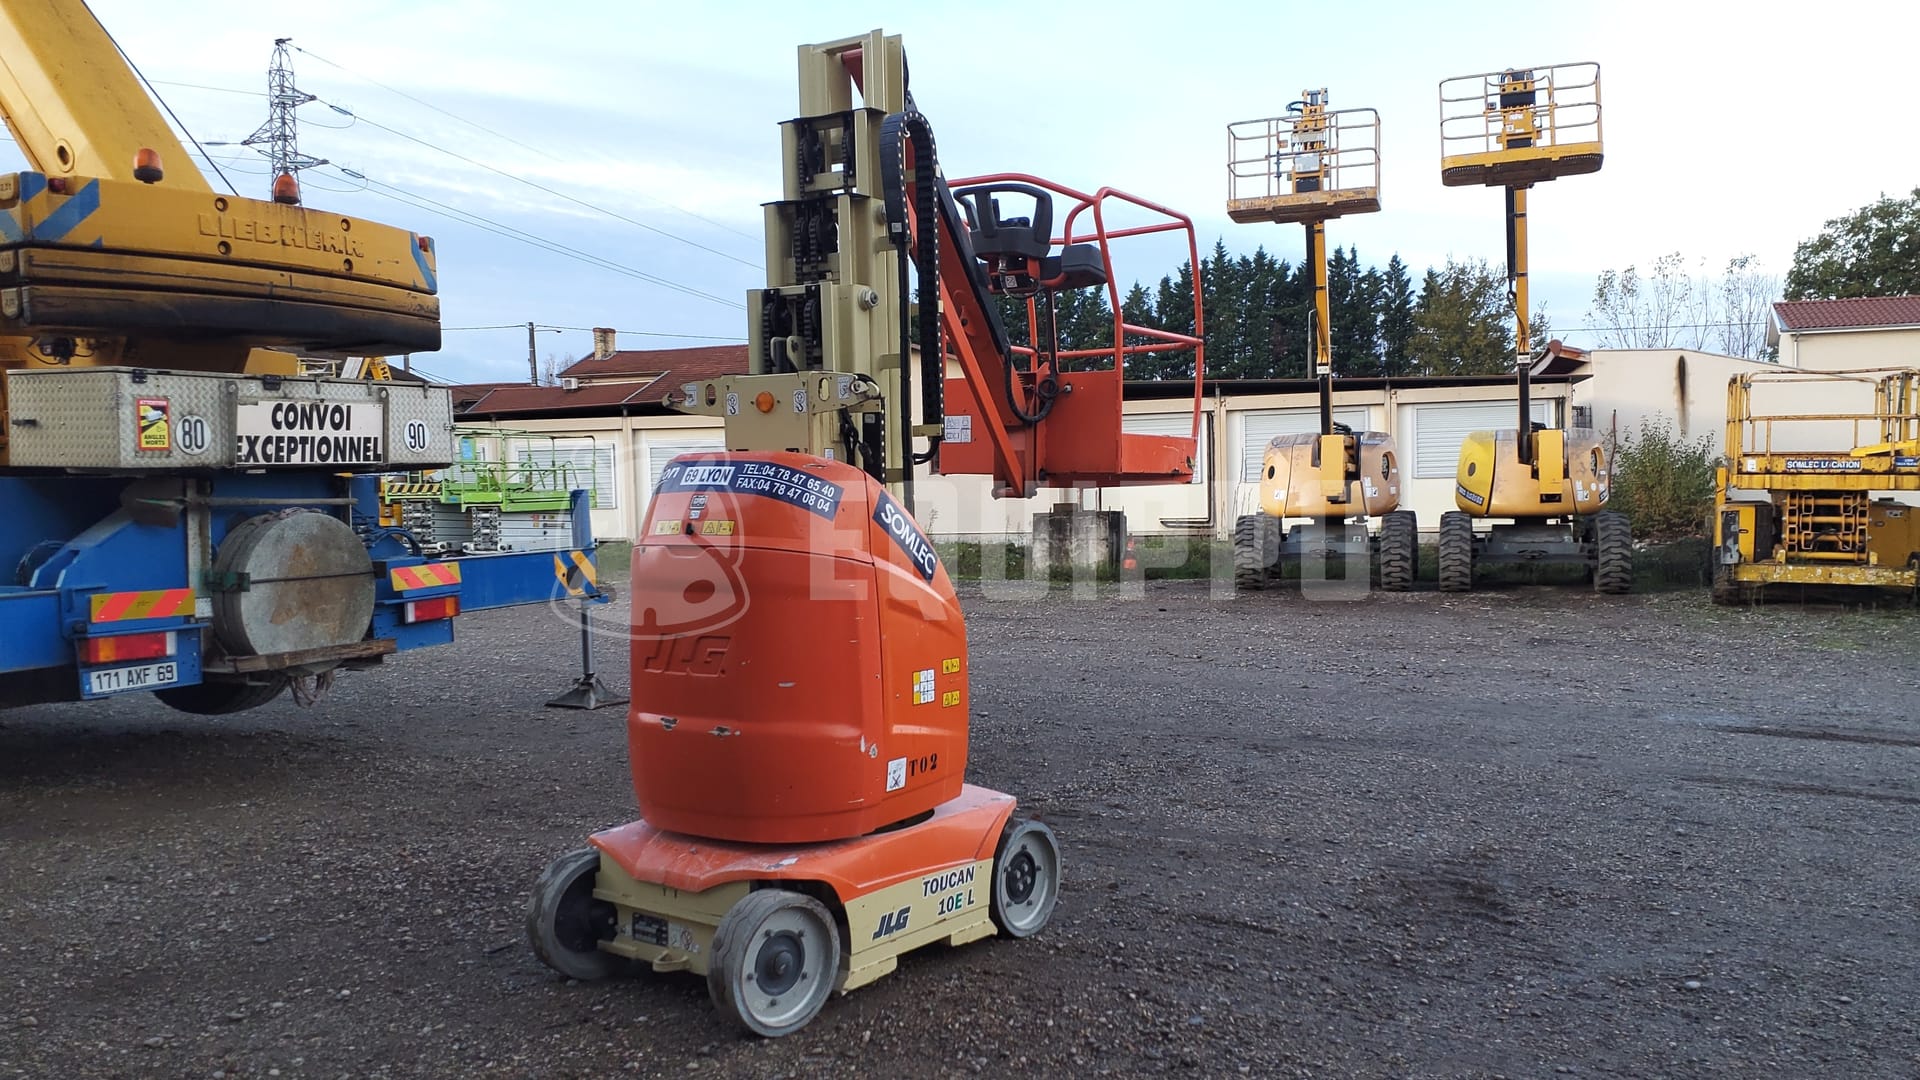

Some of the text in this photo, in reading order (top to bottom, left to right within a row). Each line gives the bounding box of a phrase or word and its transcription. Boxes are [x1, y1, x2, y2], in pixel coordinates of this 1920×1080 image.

[198, 213, 365, 258] LIEBHERR
[271, 402, 352, 431] CONVOI
[182, 418, 205, 450] 80
[236, 435, 382, 463] EXCEPTIONNEL
[408, 422, 426, 450] 90
[685, 466, 699, 482] 69
[700, 466, 731, 482] LYON
[742, 463, 835, 498] TEL:04 78 47 65 40
[735, 477, 830, 513] FAX:04 78 47 08 04
[880, 503, 936, 575] SOMLEC
[643, 632, 732, 678] JLG
[95, 664, 174, 690] 171 AXF 69
[922, 865, 976, 898] TOUCAN
[937, 888, 976, 917] 10E L
[871, 905, 912, 941] JLG
